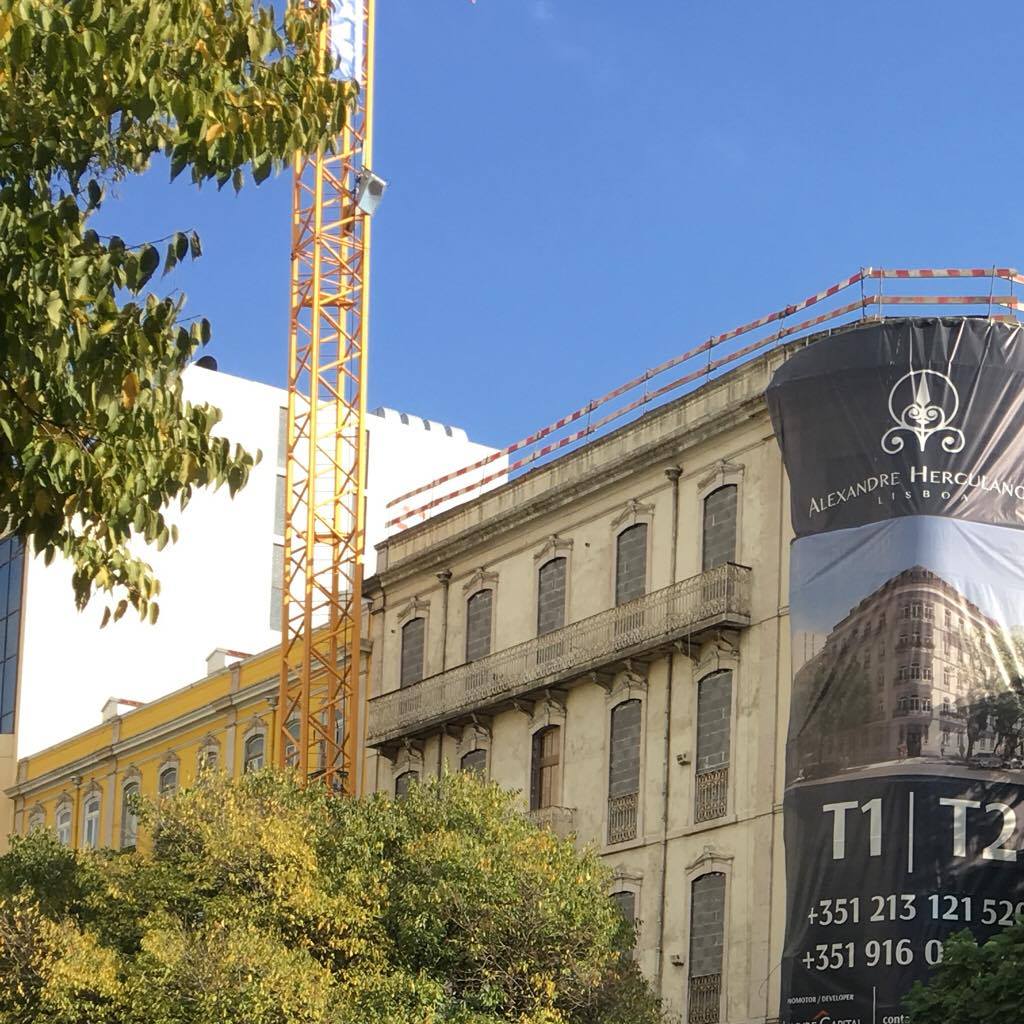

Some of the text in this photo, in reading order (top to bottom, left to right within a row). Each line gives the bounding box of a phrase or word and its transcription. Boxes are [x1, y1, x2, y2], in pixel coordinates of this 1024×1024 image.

[809, 471, 901, 518] ALEXANDRE
[877, 489, 969, 505] LISBOA
[822, 797, 1018, 862] T1 T2
[807, 897, 860, 927] +351
[869, 894, 917, 923] 213
[927, 894, 972, 922] 121
[802, 941, 855, 972] +351
[864, 938, 914, 967] 916
